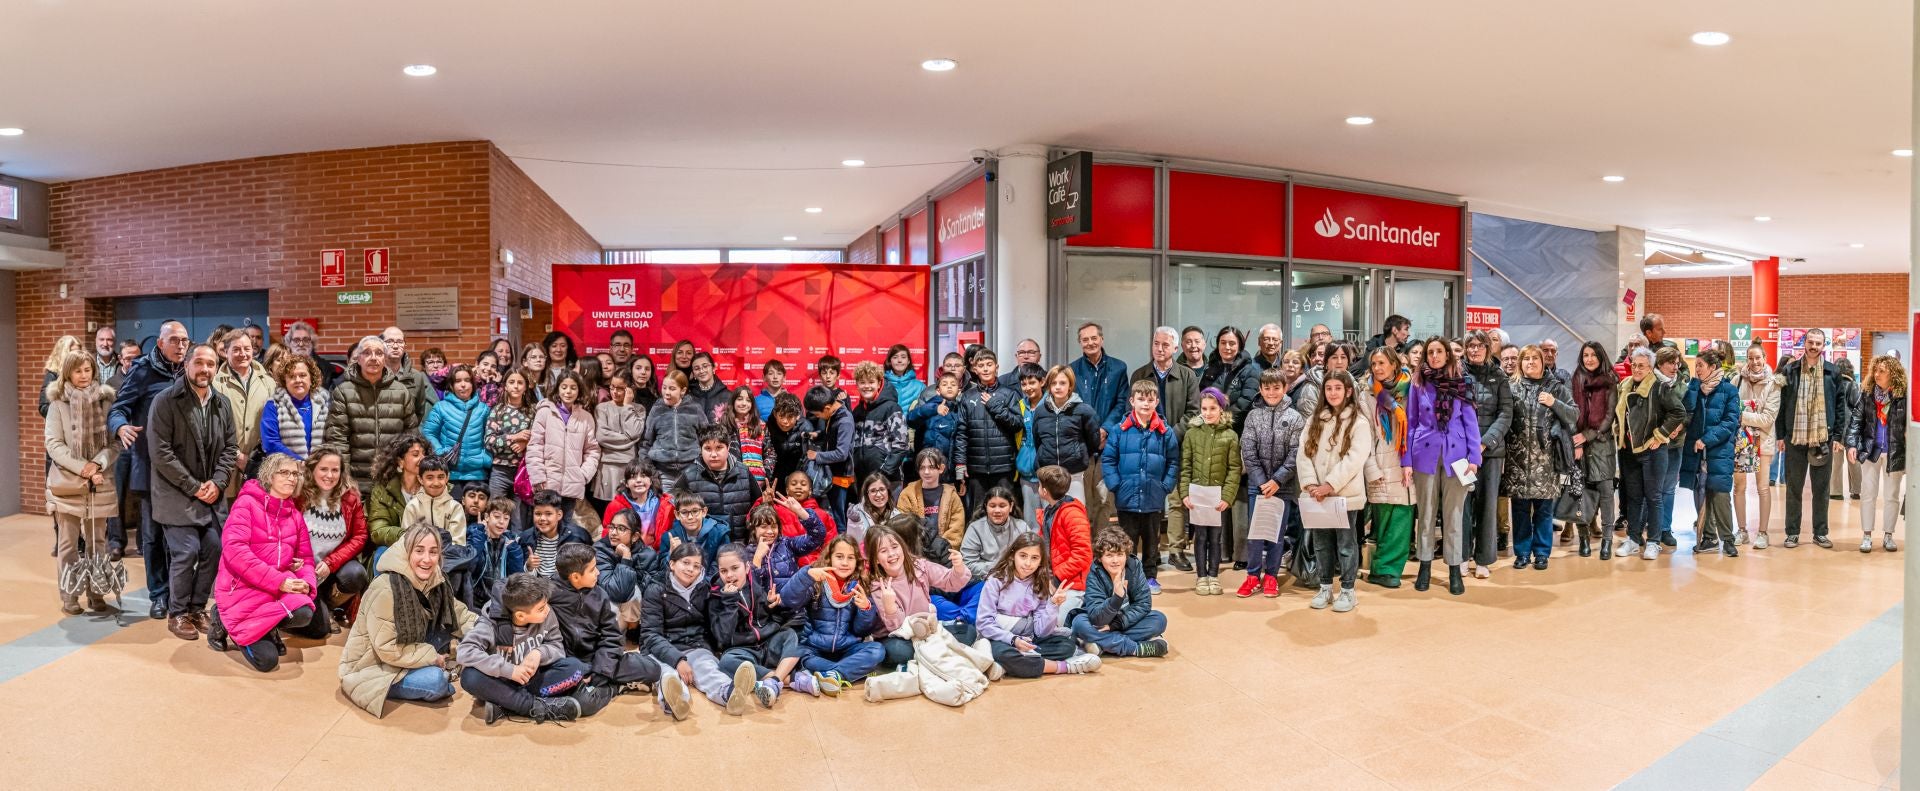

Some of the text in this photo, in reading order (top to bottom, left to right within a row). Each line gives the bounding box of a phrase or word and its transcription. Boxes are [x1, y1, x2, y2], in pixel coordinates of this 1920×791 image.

[1048, 168, 1069, 188] Work
[1048, 186, 1066, 204] Café
[946, 206, 985, 240] Santander
[1343, 216, 1441, 248] Santander
[592, 311, 653, 319] UNIVERSIDAD
[1474, 312, 1481, 324] ES
[1482, 312, 1499, 325] TENER
[596, 320, 650, 330] DE LA RIOJA
